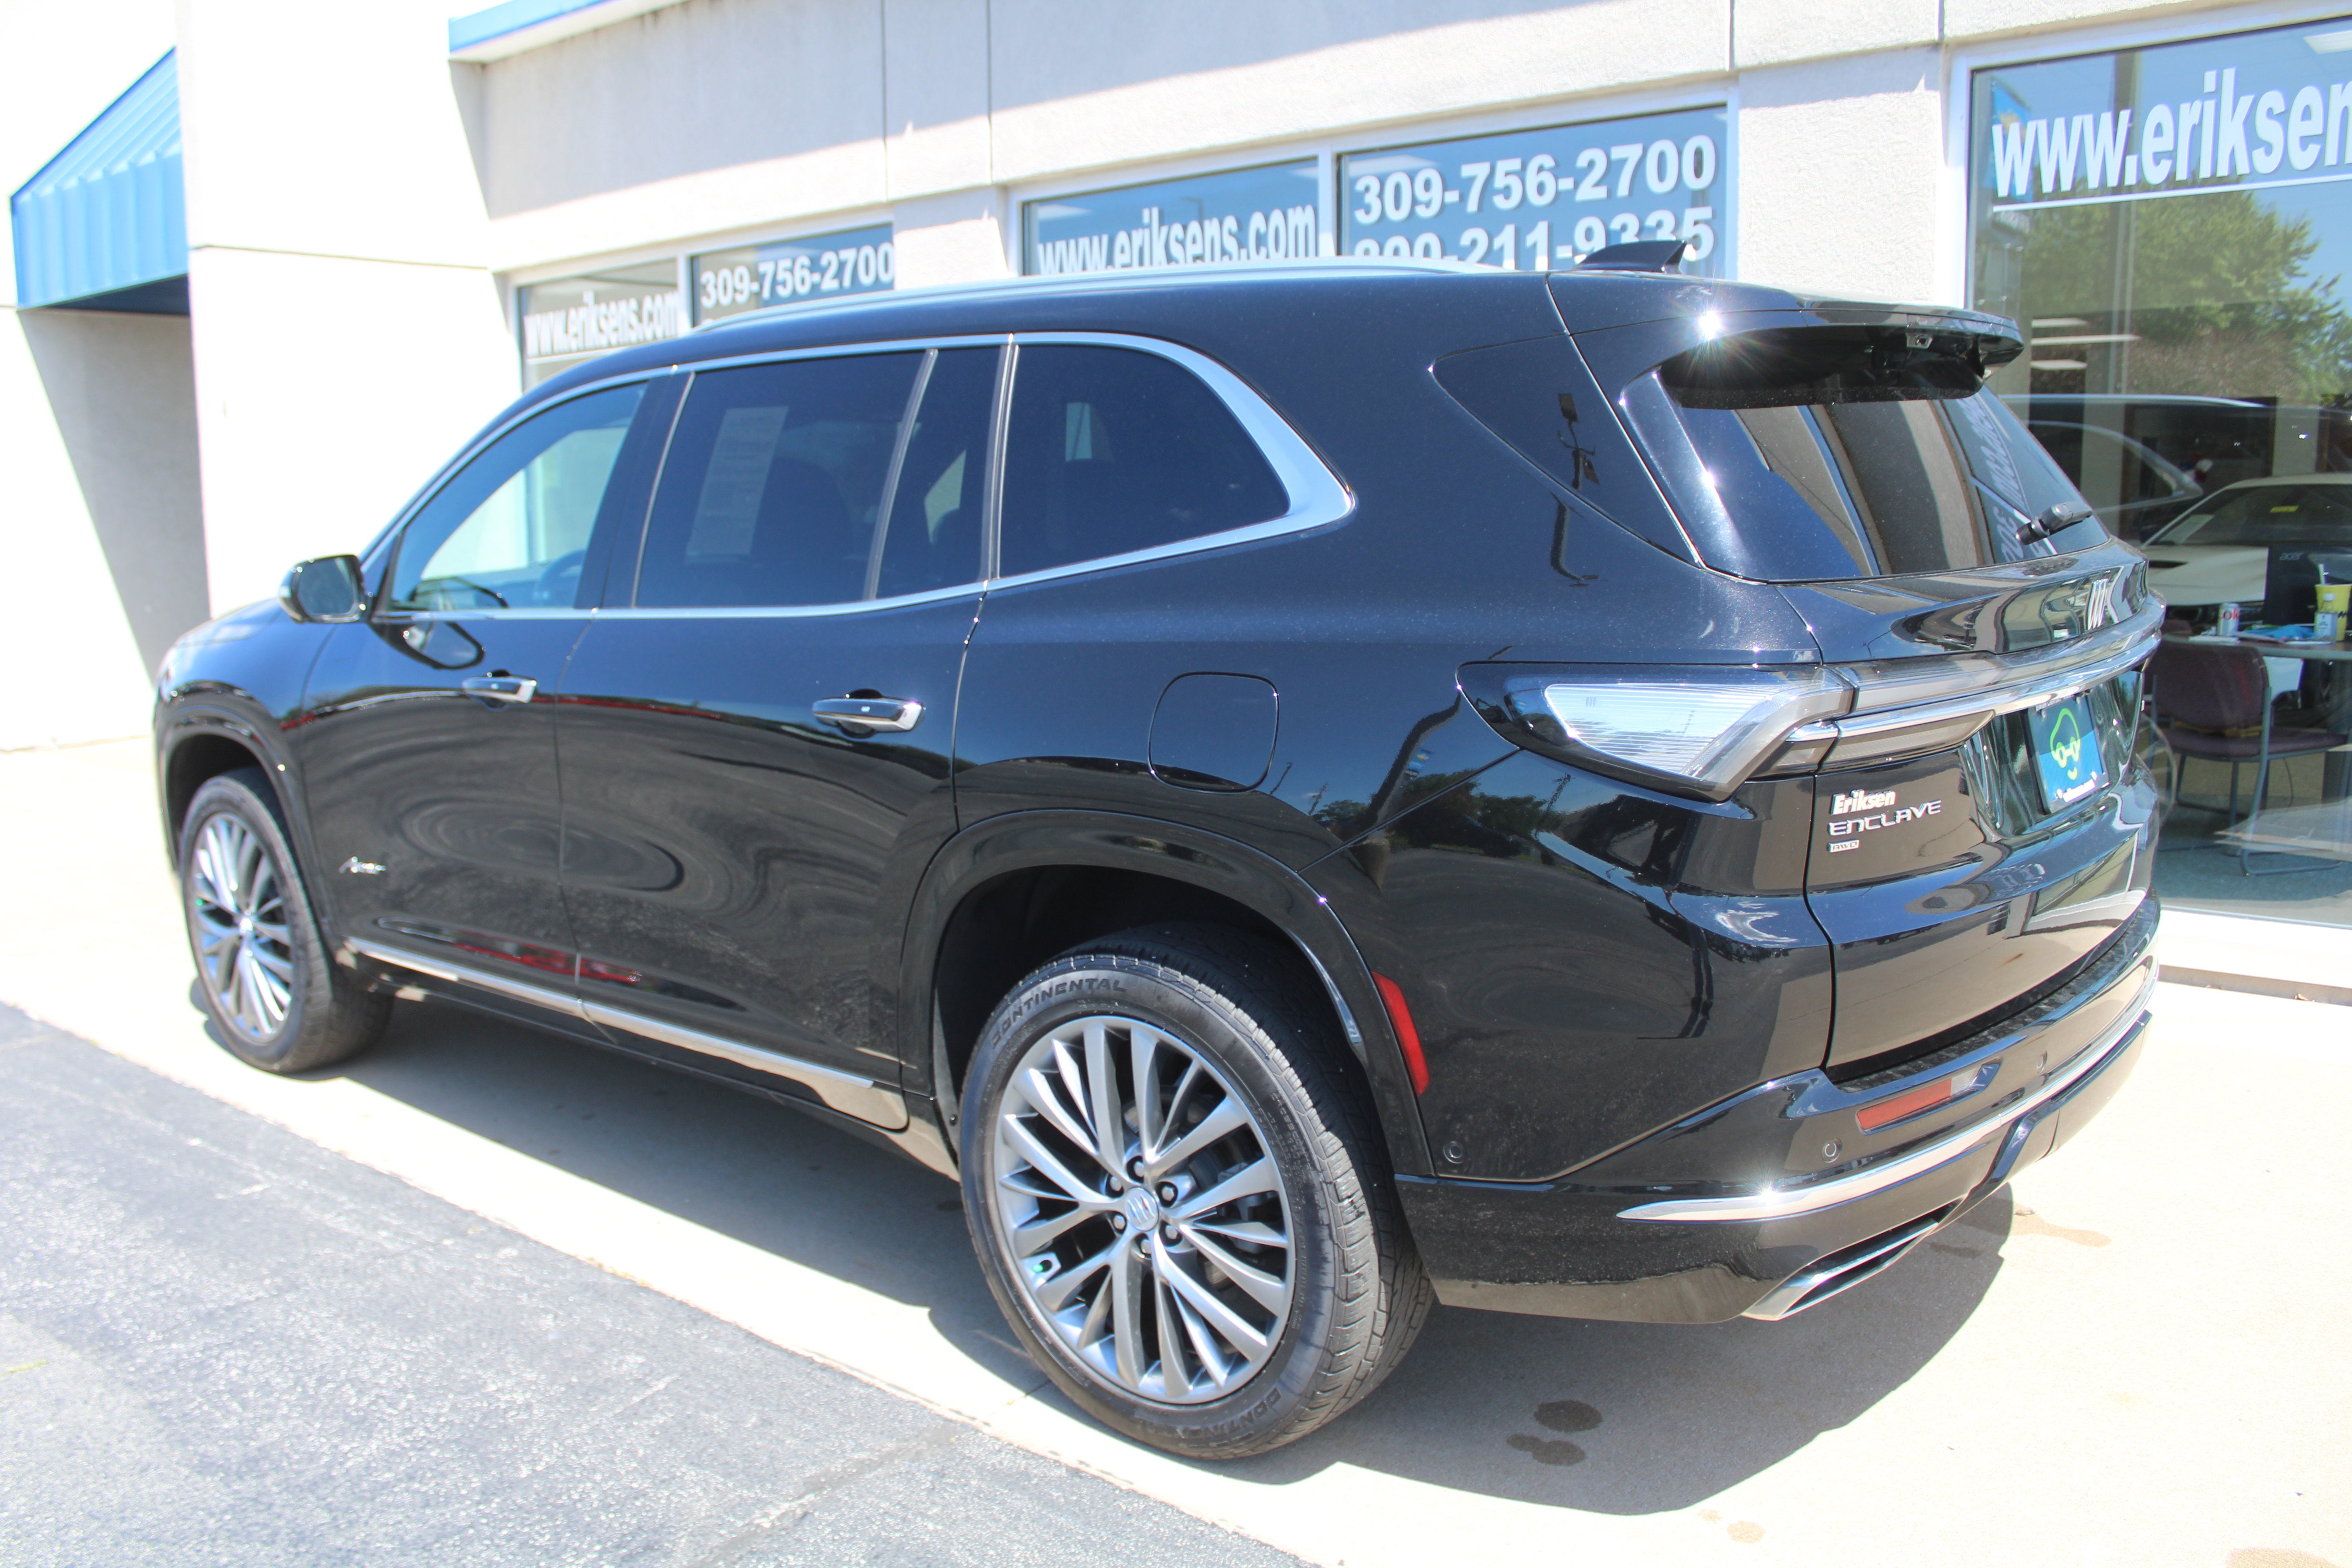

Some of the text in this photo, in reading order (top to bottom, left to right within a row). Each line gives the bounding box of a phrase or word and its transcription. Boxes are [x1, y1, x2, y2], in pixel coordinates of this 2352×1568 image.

[1354, 135, 1716, 225] 309-756-2700
[700, 243, 894, 308] 309-756-2700
[524, 290, 679, 357] www.eriksens.com
[1828, 800, 1941, 836] ENCLAVE
[1830, 788, 1896, 815] Eriksen
[1831, 840, 1859, 852] AWD
[991, 978, 1128, 1049] CONTINENTAL
